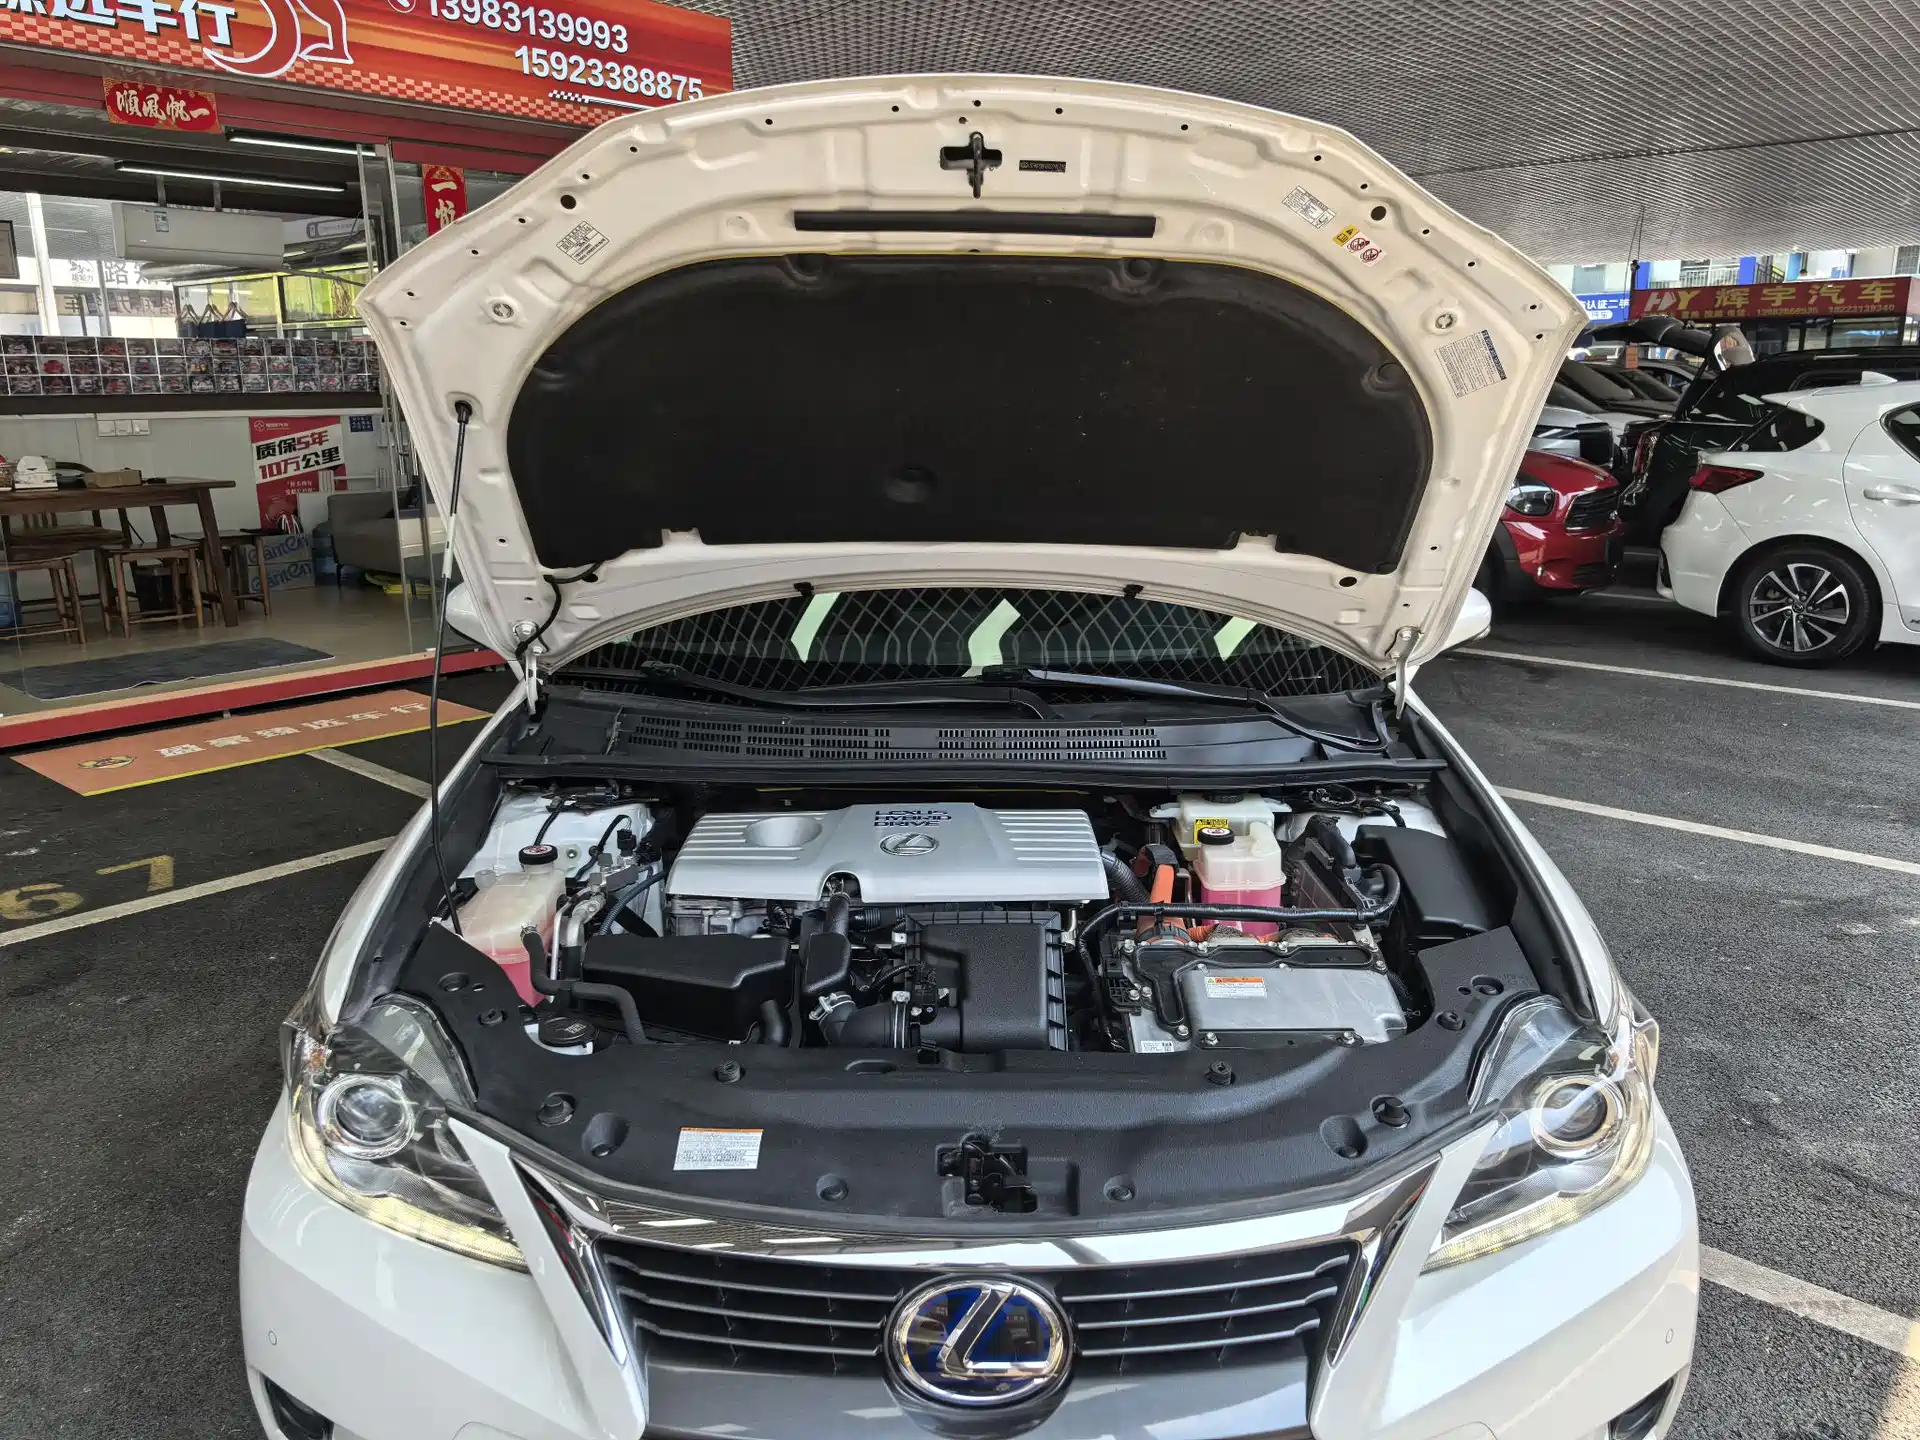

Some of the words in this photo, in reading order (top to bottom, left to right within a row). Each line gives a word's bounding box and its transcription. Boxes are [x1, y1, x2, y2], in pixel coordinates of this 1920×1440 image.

[428, 0, 629, 53] 13983139993
[514, 45, 704, 102] 15923388875
[1714, 281, 1897, 309] 辉宇汽车
[256, 430, 329, 460] 质保5年
[259, 446, 341, 480] 10万公里
